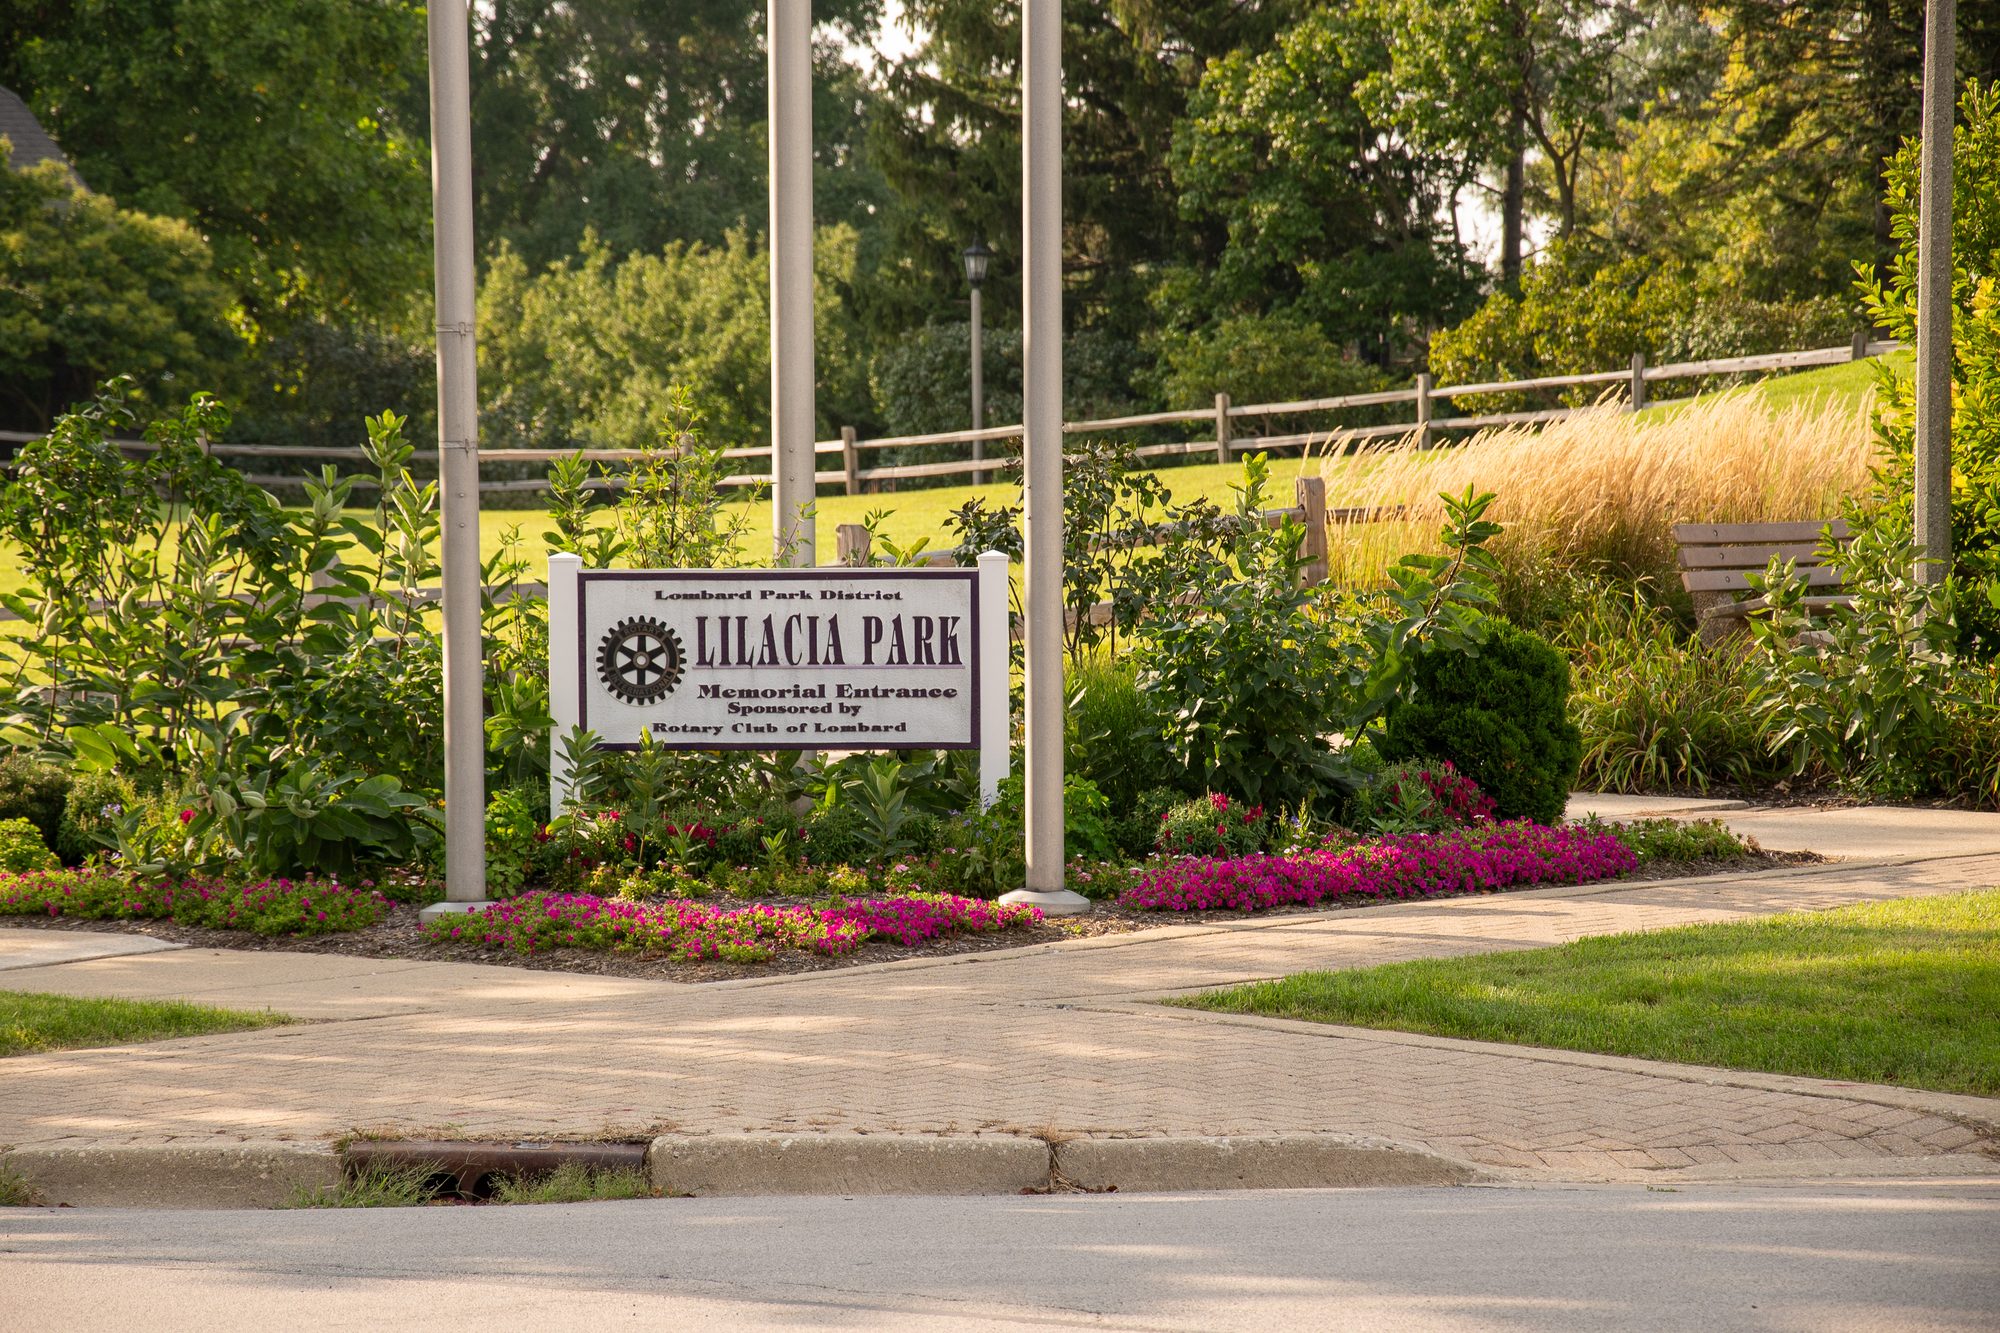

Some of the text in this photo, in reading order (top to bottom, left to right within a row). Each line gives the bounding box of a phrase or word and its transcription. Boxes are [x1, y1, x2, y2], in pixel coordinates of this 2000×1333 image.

[655, 590, 903, 600] Lombard Park District
[623, 624, 661, 635] ROTARY
[696, 612, 963, 668] LILACIA PARK
[608, 671, 673, 696] INTERNATIONAL
[697, 684, 958, 699] Memorial Entrance
[727, 701, 861, 717] Sponsored by
[652, 722, 906, 736] Rotary Club of Lombard
